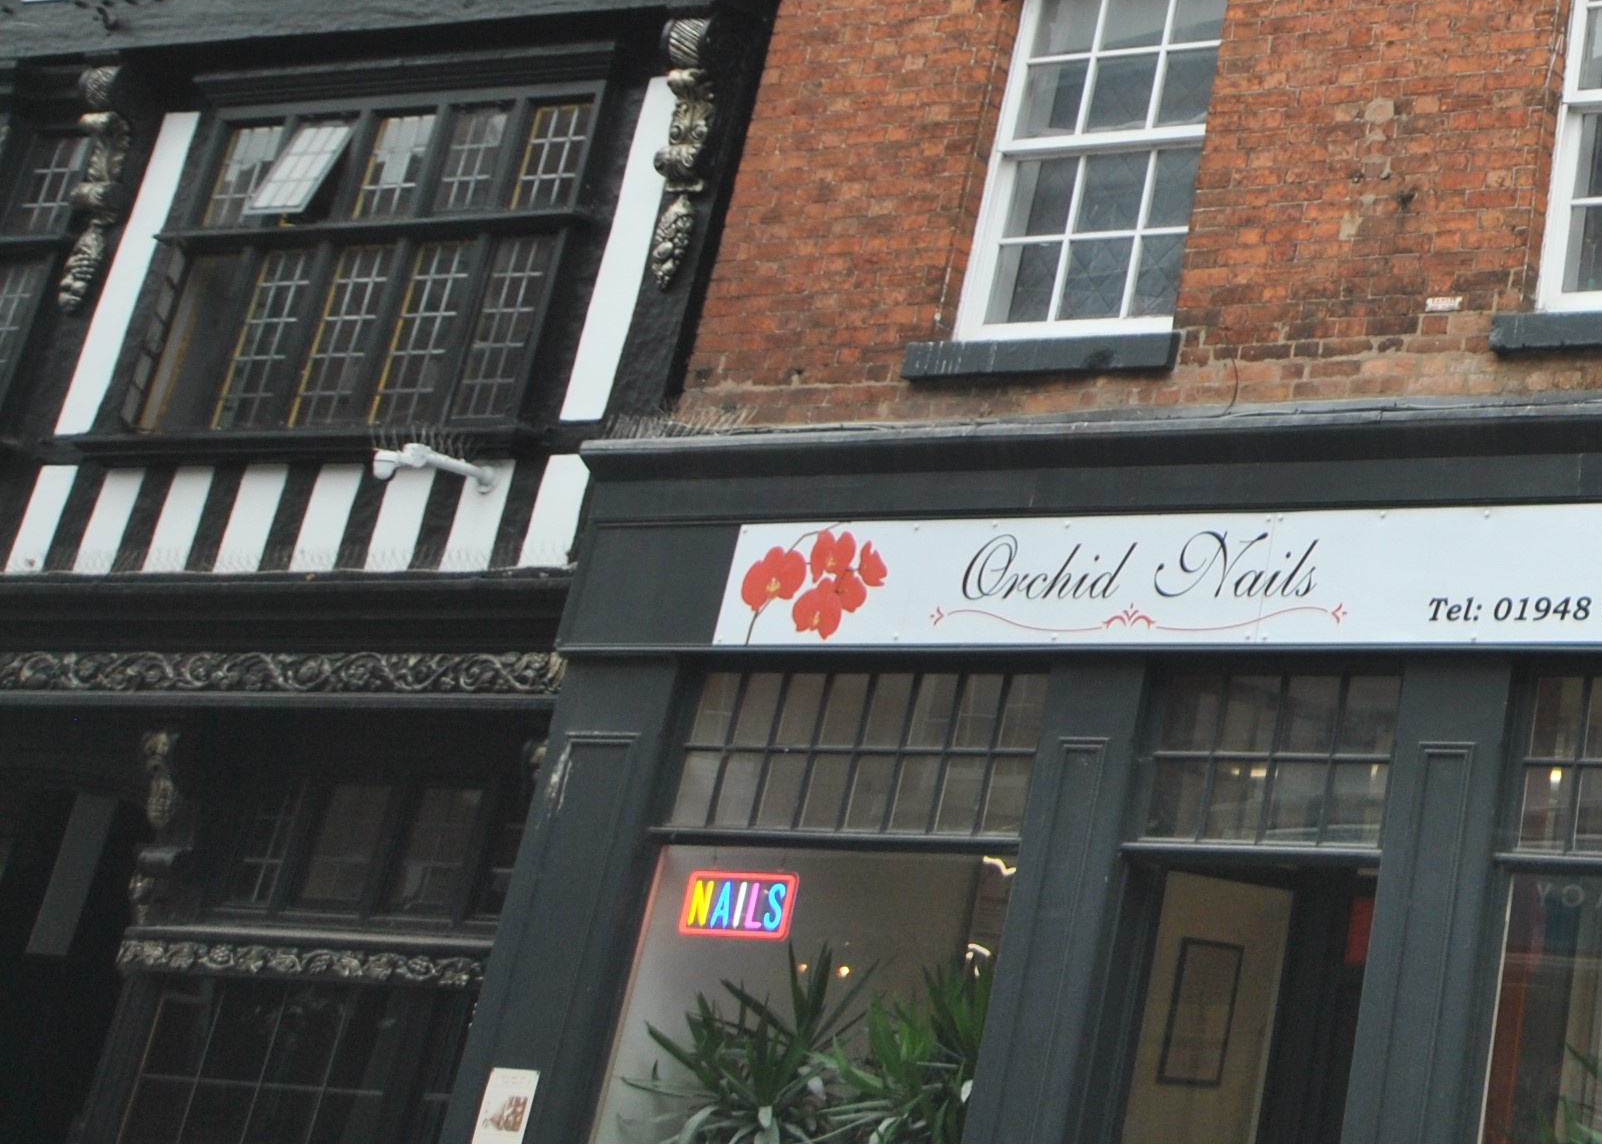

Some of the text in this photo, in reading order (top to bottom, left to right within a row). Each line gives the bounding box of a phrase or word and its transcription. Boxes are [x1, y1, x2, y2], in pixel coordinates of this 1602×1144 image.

[961, 530, 1320, 601] Orchid Nails
[1428, 596, 1483, 622] Tel:
[1493, 596, 1592, 622] 01948
[687, 879, 787, 931] NAILS
